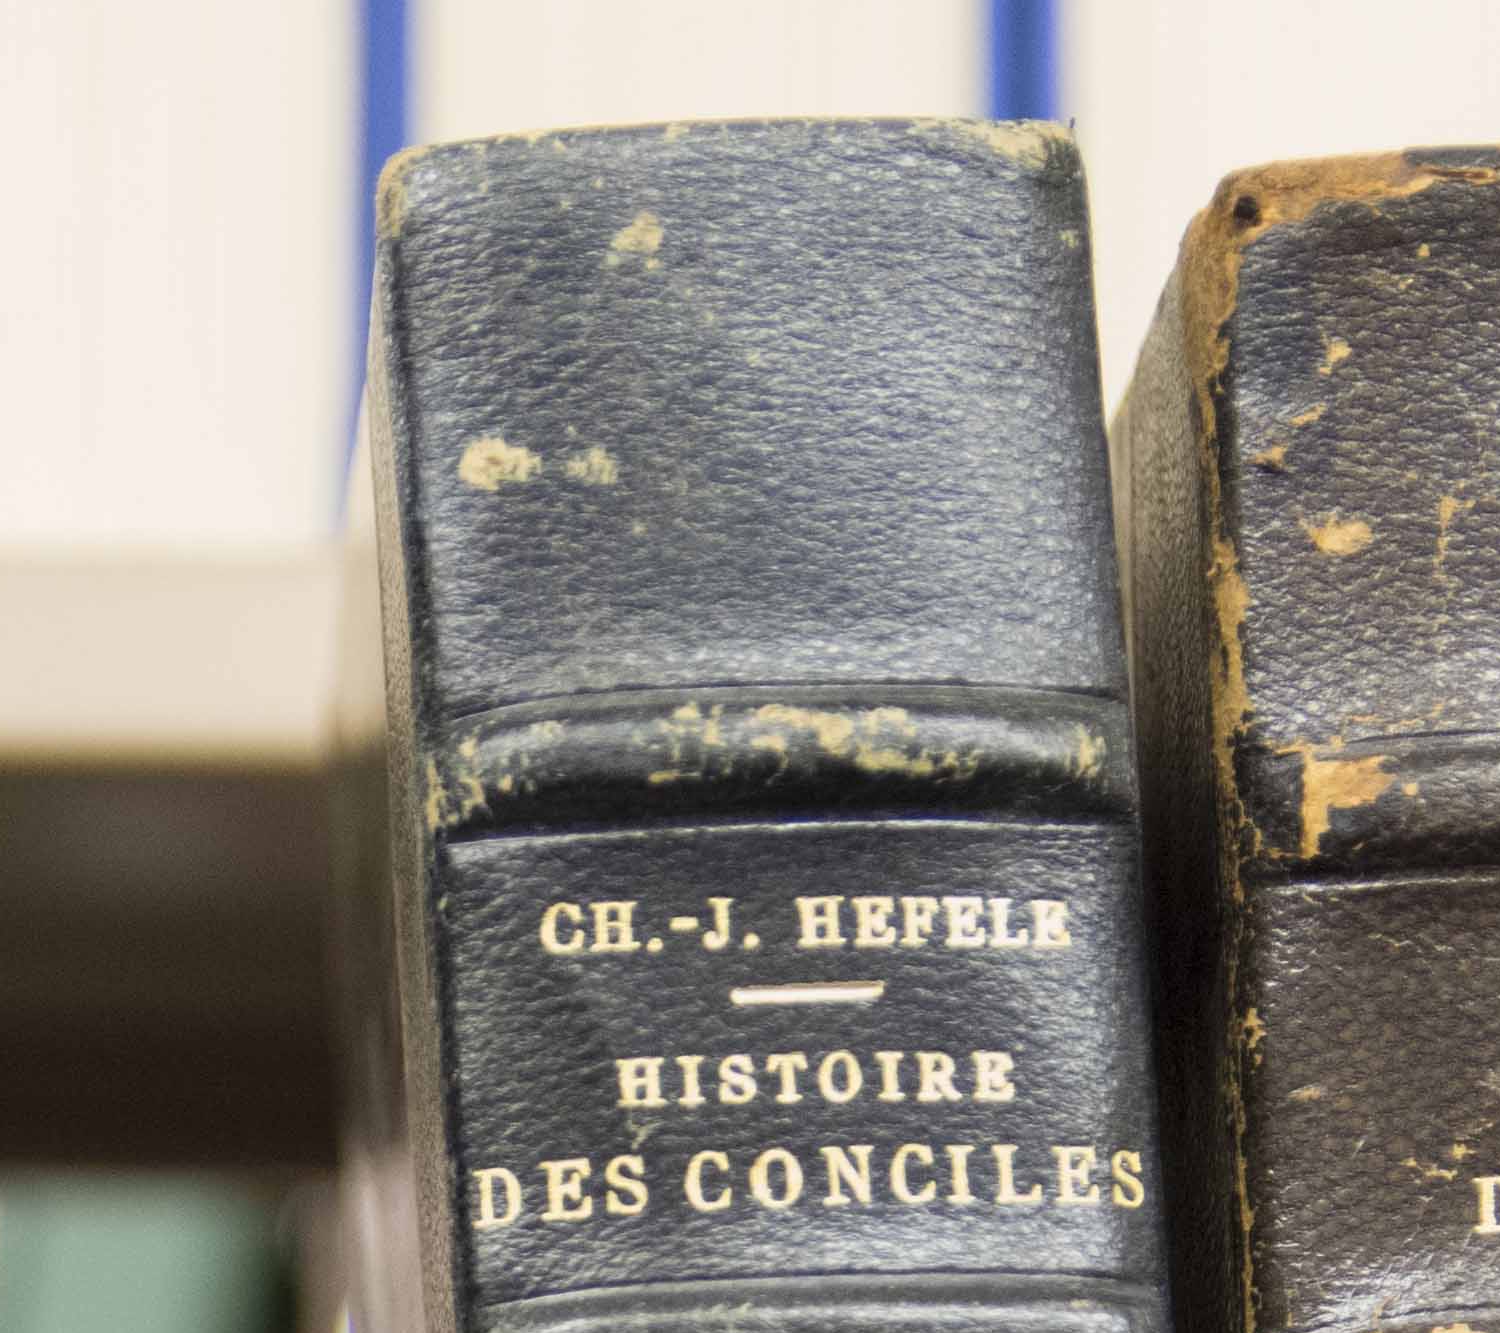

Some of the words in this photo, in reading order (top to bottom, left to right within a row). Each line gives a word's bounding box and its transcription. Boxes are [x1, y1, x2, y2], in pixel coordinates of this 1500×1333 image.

[538, 894, 761, 956] CH.-J.
[796, 894, 1073, 953] HEFELE
[616, 1050, 1018, 1110] HISTOIRE
[472, 1153, 649, 1231] DES
[683, 1140, 1147, 1214] CONCILES
